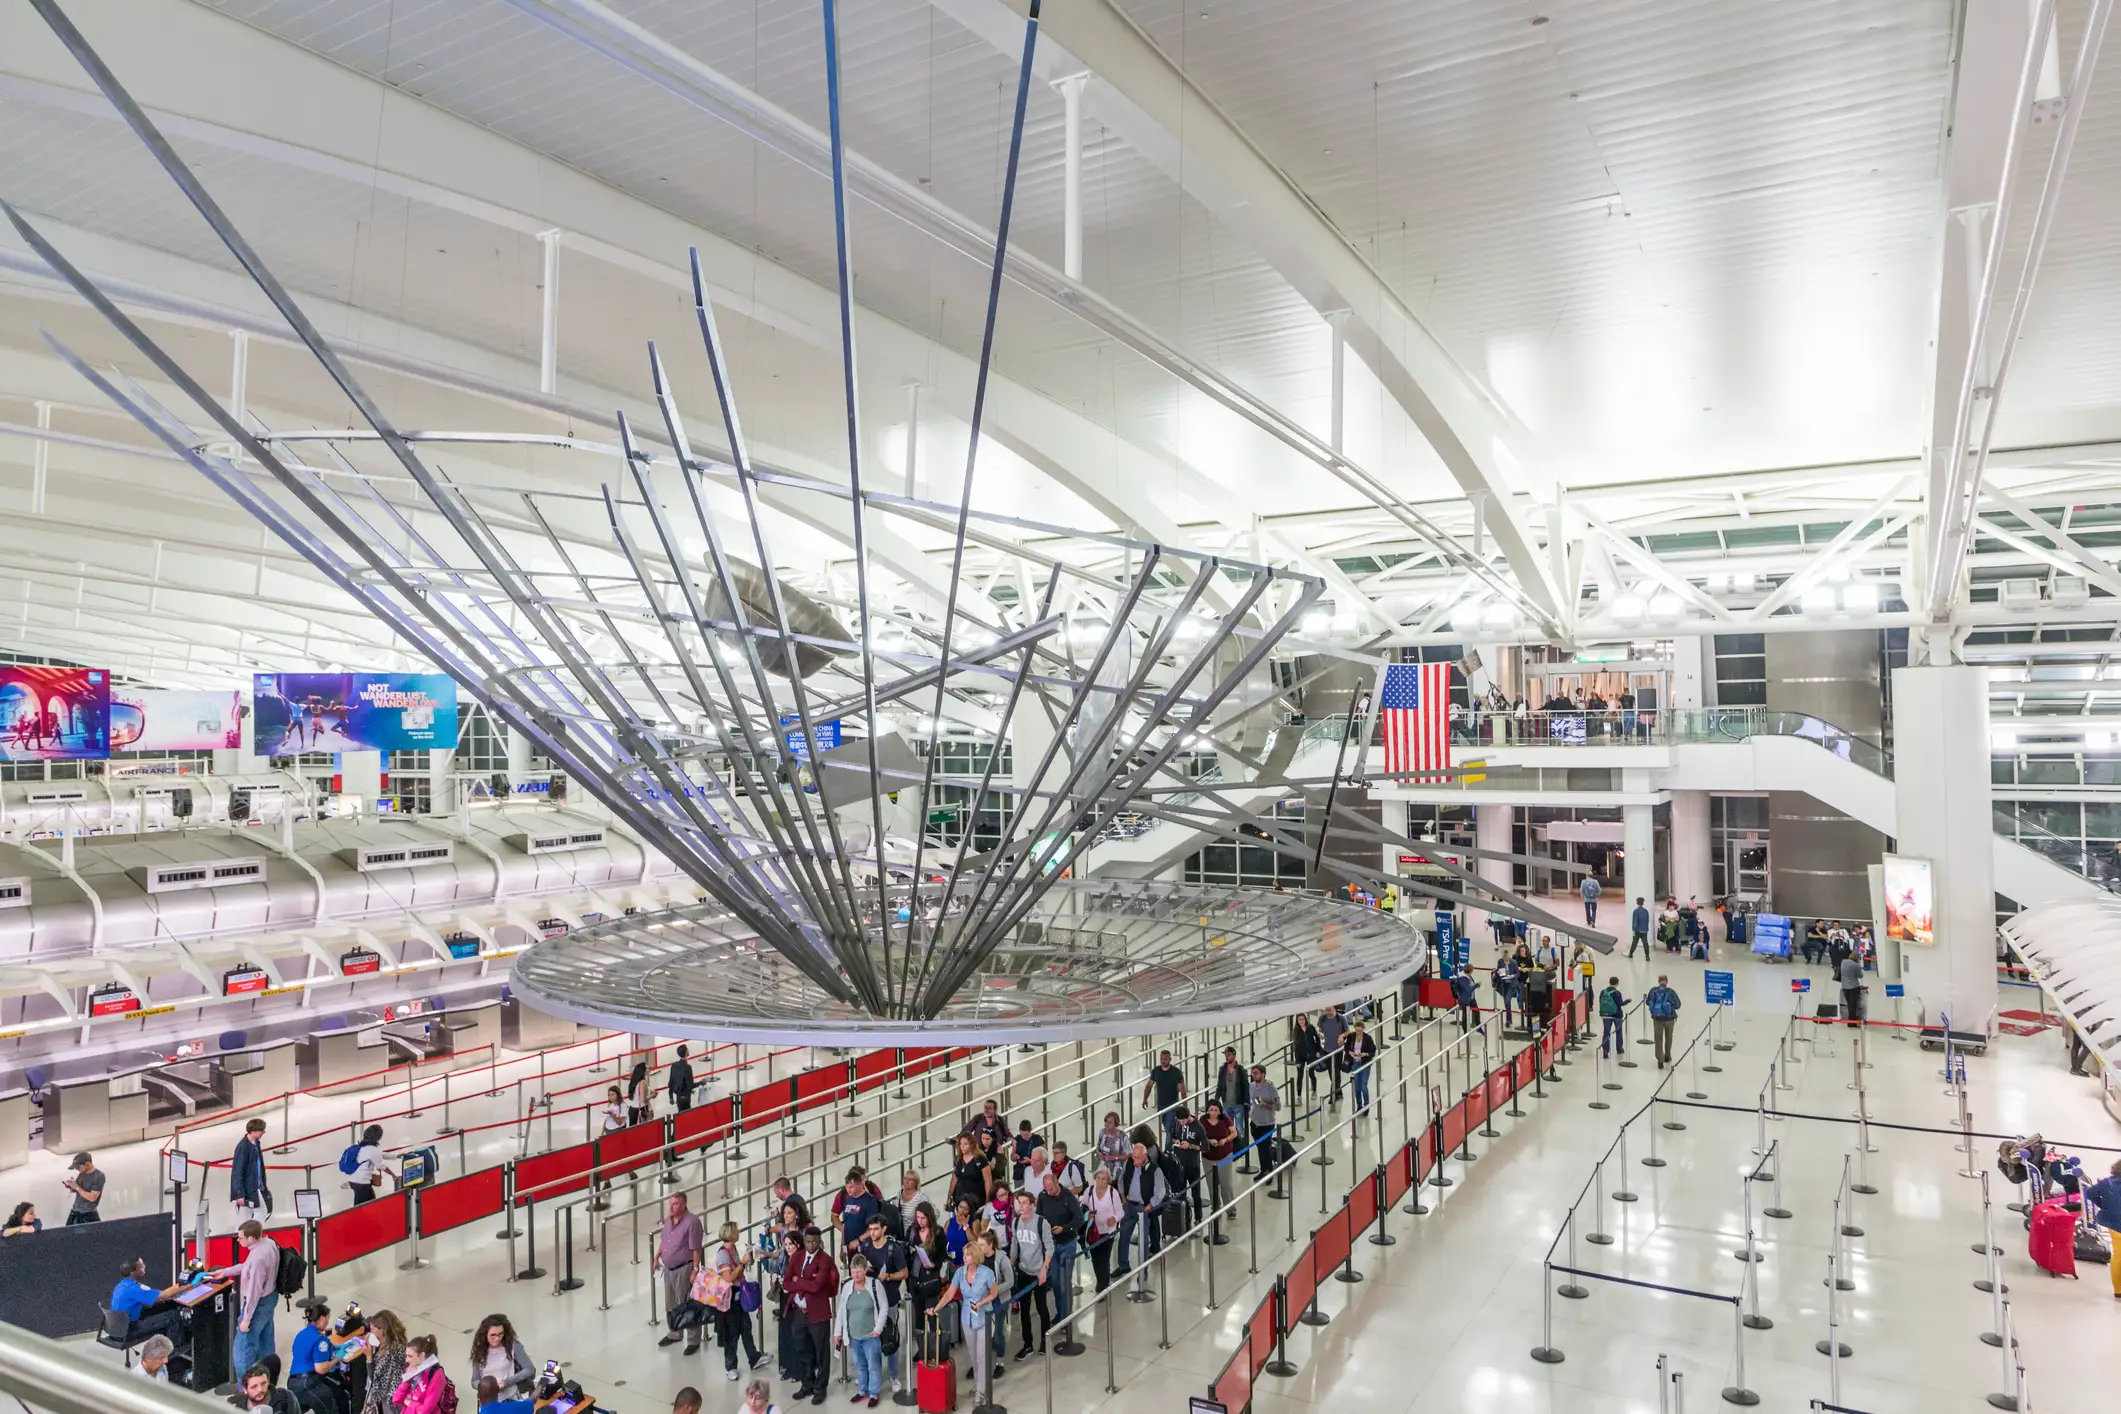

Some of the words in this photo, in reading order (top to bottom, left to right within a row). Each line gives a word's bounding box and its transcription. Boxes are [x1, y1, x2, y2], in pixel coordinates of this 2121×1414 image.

[367, 683, 390, 693] NOT
[117, 767, 178, 776] AIRFRANCE
[1442, 928, 1450, 944] TSA
[1442, 945, 1450, 958] Pre
